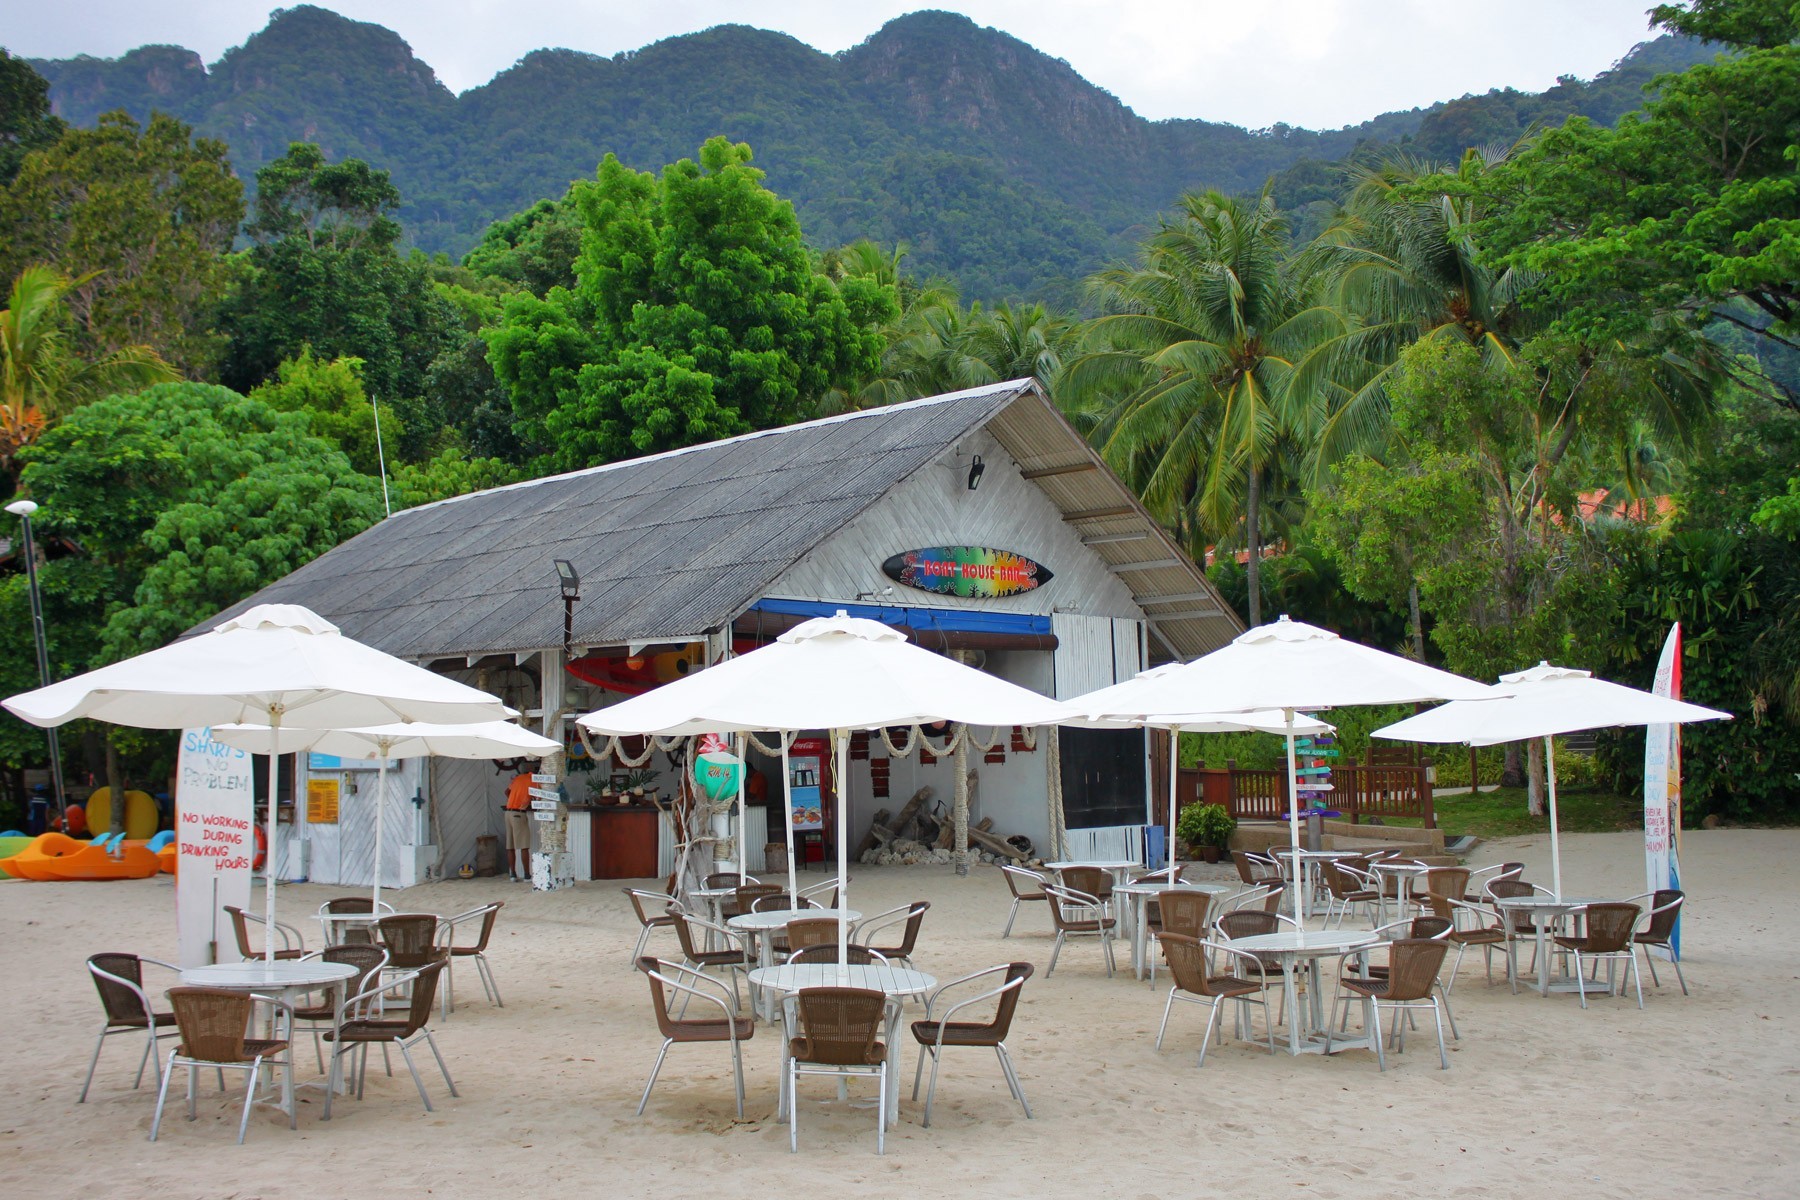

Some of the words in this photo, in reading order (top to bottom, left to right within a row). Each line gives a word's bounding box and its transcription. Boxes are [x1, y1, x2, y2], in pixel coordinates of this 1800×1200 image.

[923, 560, 957, 577] BOAT
[961, 563, 995, 580] HOUSE
[1000, 566, 1021, 581] BAR
[206, 758, 229, 771] NO
[183, 767, 249, 791] PROBLEM
[183, 812, 199, 823] NO
[201, 813, 249, 830] WORKING
[202, 829, 243, 844] DURING
[180, 843, 229, 857] DRINKING
[215, 857, 249, 871] HOURS
